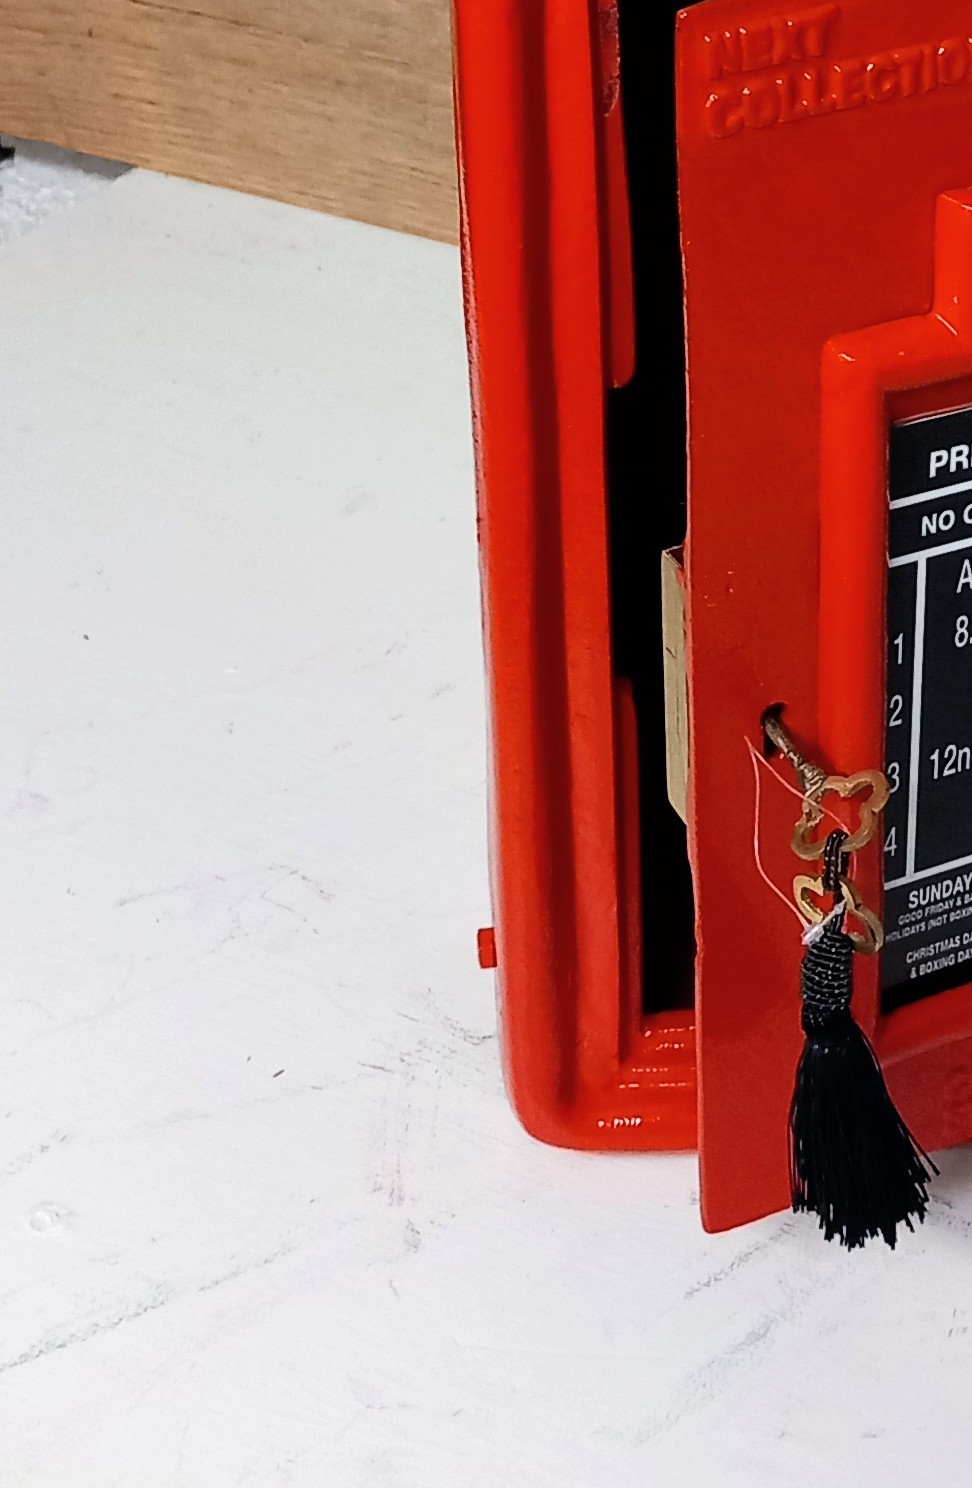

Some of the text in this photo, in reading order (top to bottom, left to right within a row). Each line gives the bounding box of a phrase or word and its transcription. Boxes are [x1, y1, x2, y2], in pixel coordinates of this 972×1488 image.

[704, 4, 842, 82] NEXT
[921, 509, 956, 538] NO
[893, 632, 904, 665] 1
[888, 694, 903, 727] 2
[886, 761, 901, 795] 3
[883, 826, 898, 857] 4
[898, 908, 923, 926] GOOD
[925, 898, 956, 917] FRIDAY
[906, 934, 962, 964] CHRISTMAS
[909, 966, 918, 980] &
[919, 953, 956, 976] BOXING
